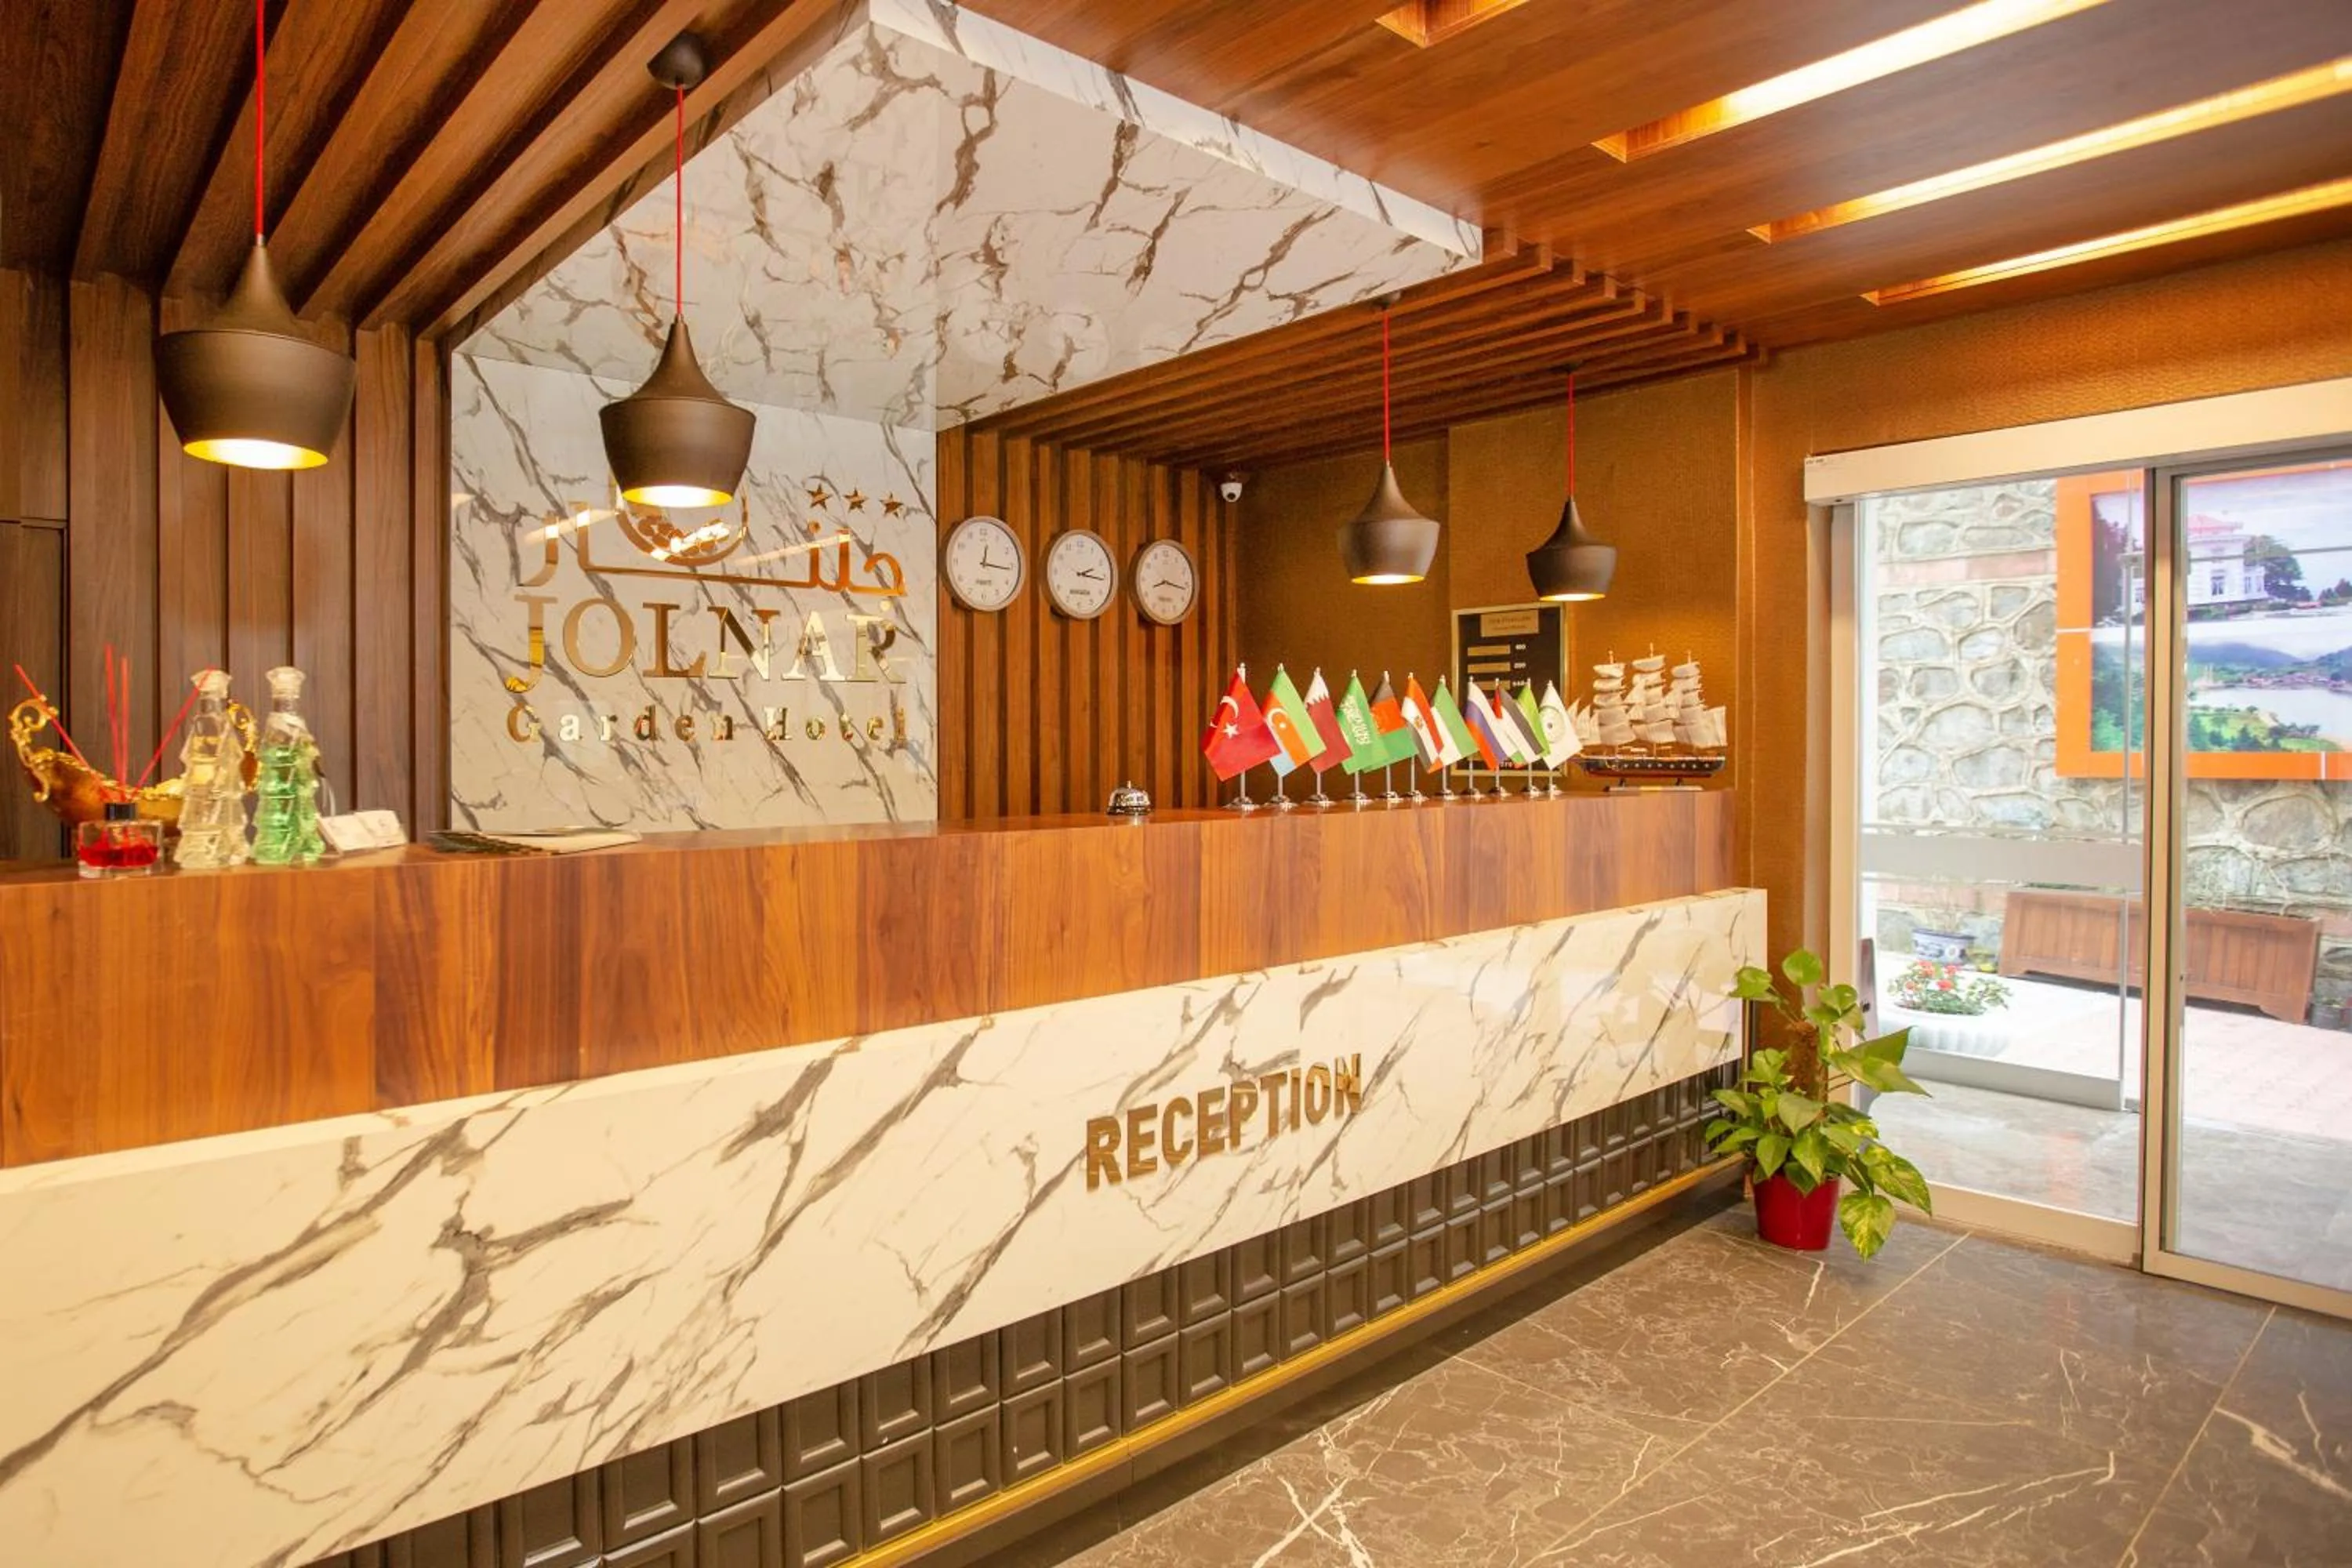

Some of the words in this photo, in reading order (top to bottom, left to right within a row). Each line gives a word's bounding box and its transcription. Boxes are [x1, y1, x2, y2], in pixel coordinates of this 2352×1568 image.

[504, 594, 907, 693] JOLNAR
[506, 706, 734, 742] Garden
[764, 707, 907, 742] Hotel
[1086, 1053, 1362, 1192] RECEPTION
